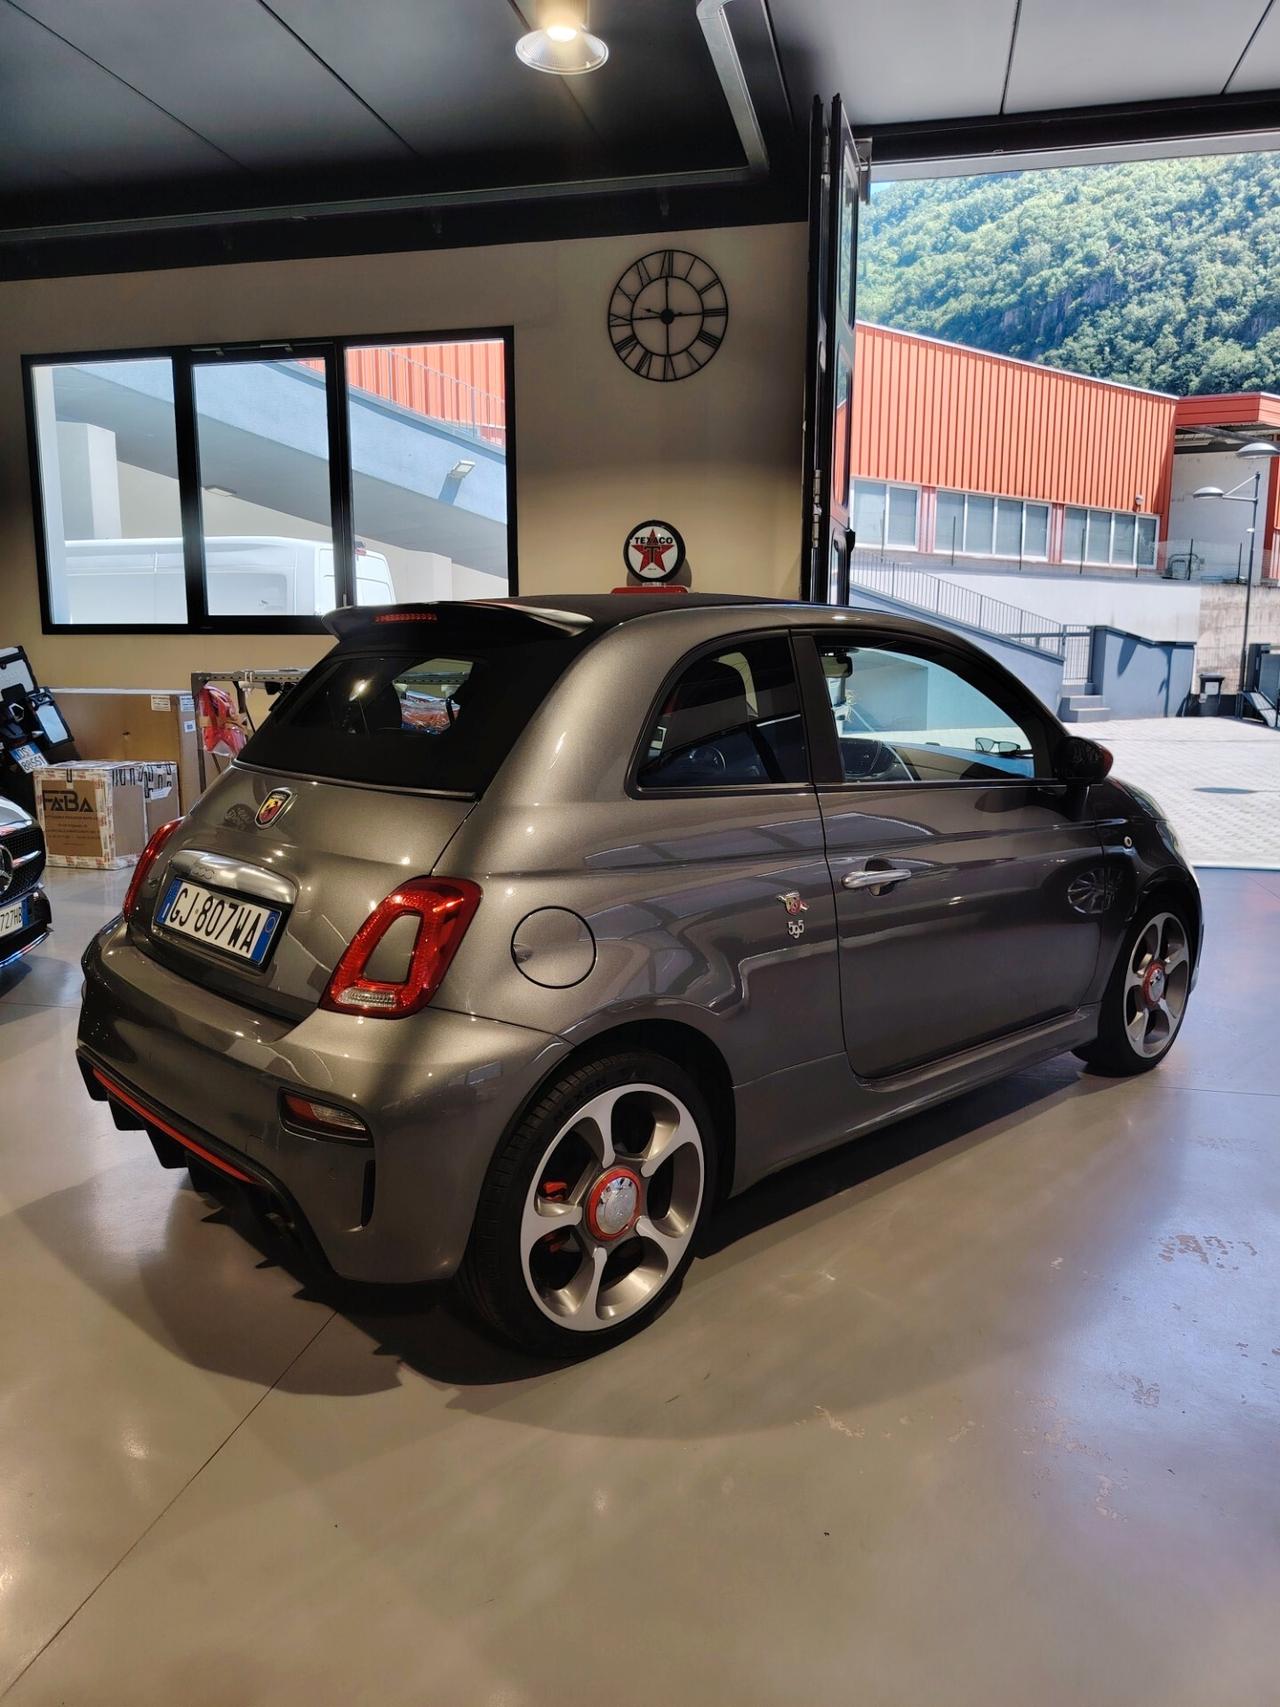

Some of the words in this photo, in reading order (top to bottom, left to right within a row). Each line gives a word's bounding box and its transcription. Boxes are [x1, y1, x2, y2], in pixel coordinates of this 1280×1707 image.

[635, 536, 673, 544] TEXACO
[169, 887, 200, 927] GJ
[194, 895, 262, 954] 807WA
[788, 920, 805, 939] 595
